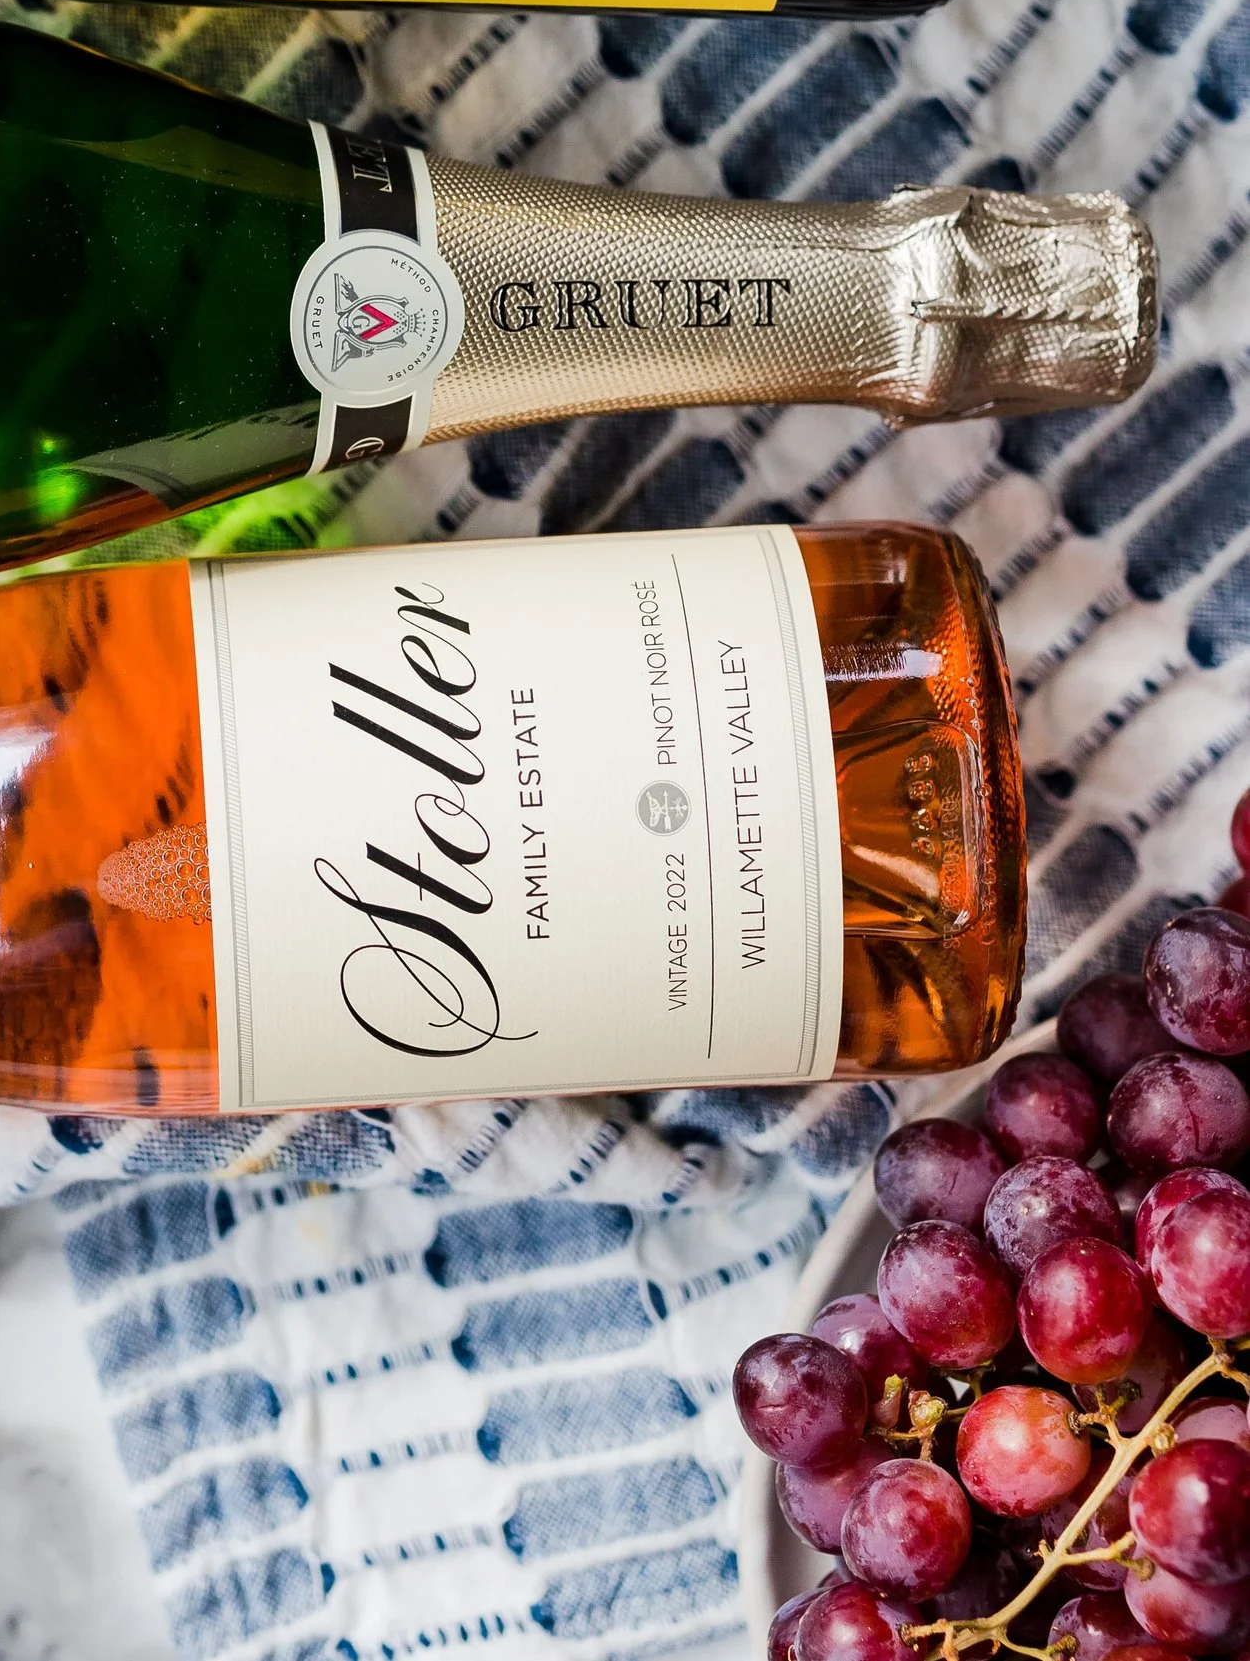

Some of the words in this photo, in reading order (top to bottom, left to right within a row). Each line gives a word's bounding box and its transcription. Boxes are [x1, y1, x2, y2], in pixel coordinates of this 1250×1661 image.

[391, 258, 431, 293] MÉTHOD
[489, 277, 792, 334] GRUET
[311, 296, 325, 349] GRUET
[387, 309, 439, 382] CHAMPENOISE
[630, 579, 662, 626] ROSÉ
[645, 632, 669, 686] NOIR
[651, 693, 677, 765] PINOT
[717, 639, 754, 755] VALLEY
[510, 687, 544, 808] ESTATE
[313, 581, 539, 1058] Stoller
[519, 823, 550, 942] FAMILY
[665, 852, 687, 912] 2022
[731, 764, 766, 970] WILLAMETTE
[668, 923, 688, 1011] VINTAGE
